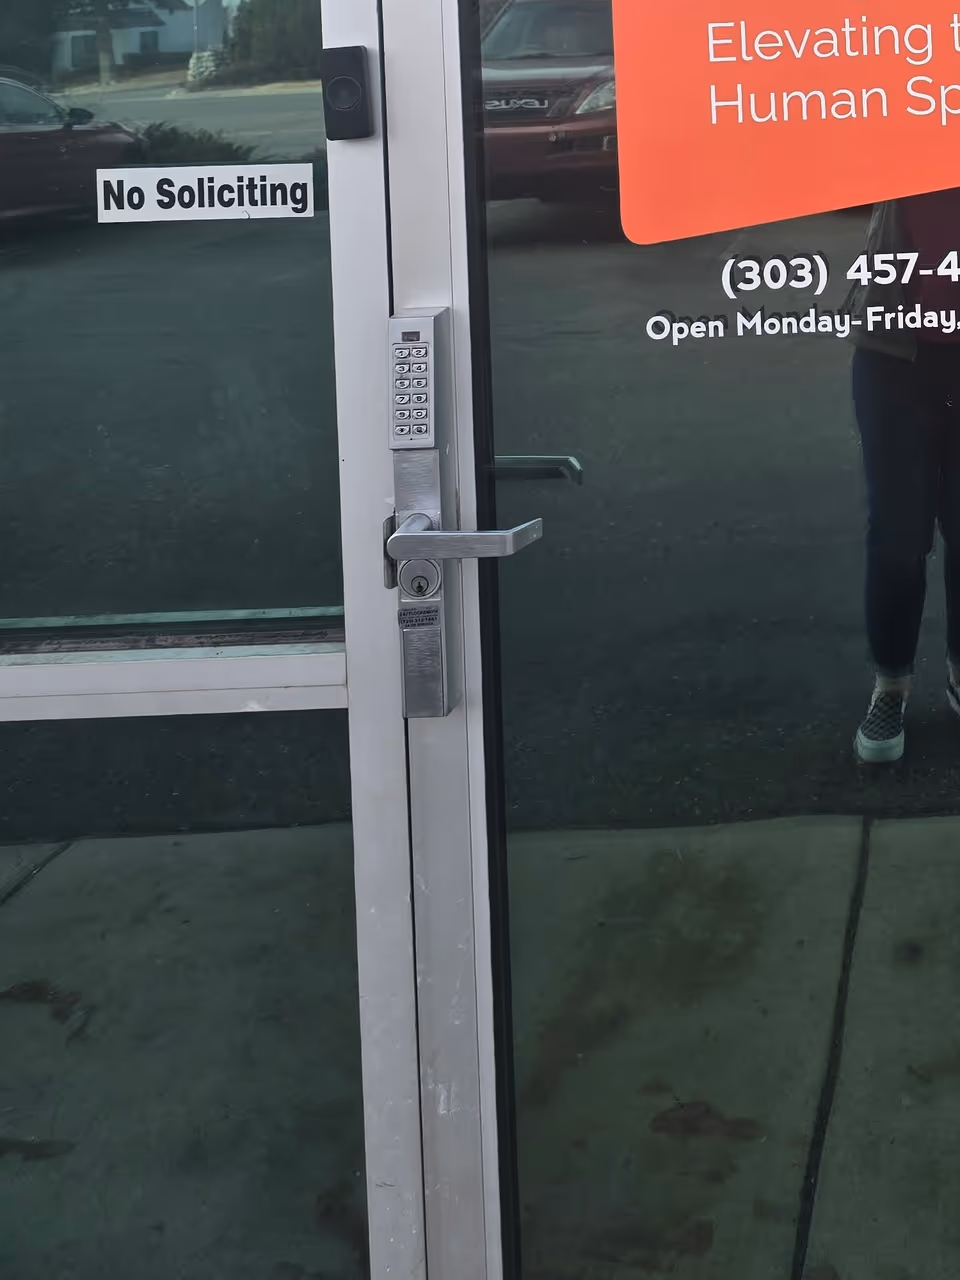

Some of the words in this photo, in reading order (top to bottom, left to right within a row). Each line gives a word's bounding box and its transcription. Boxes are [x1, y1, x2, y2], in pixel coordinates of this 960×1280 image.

[707, 15, 933, 66] Elevating
[709, 82, 888, 125] Human
[103, 179, 145, 211] No
[156, 175, 308, 213] Soliciting
[721, 254, 828, 299] (303)
[646, 315, 724, 346] Open
